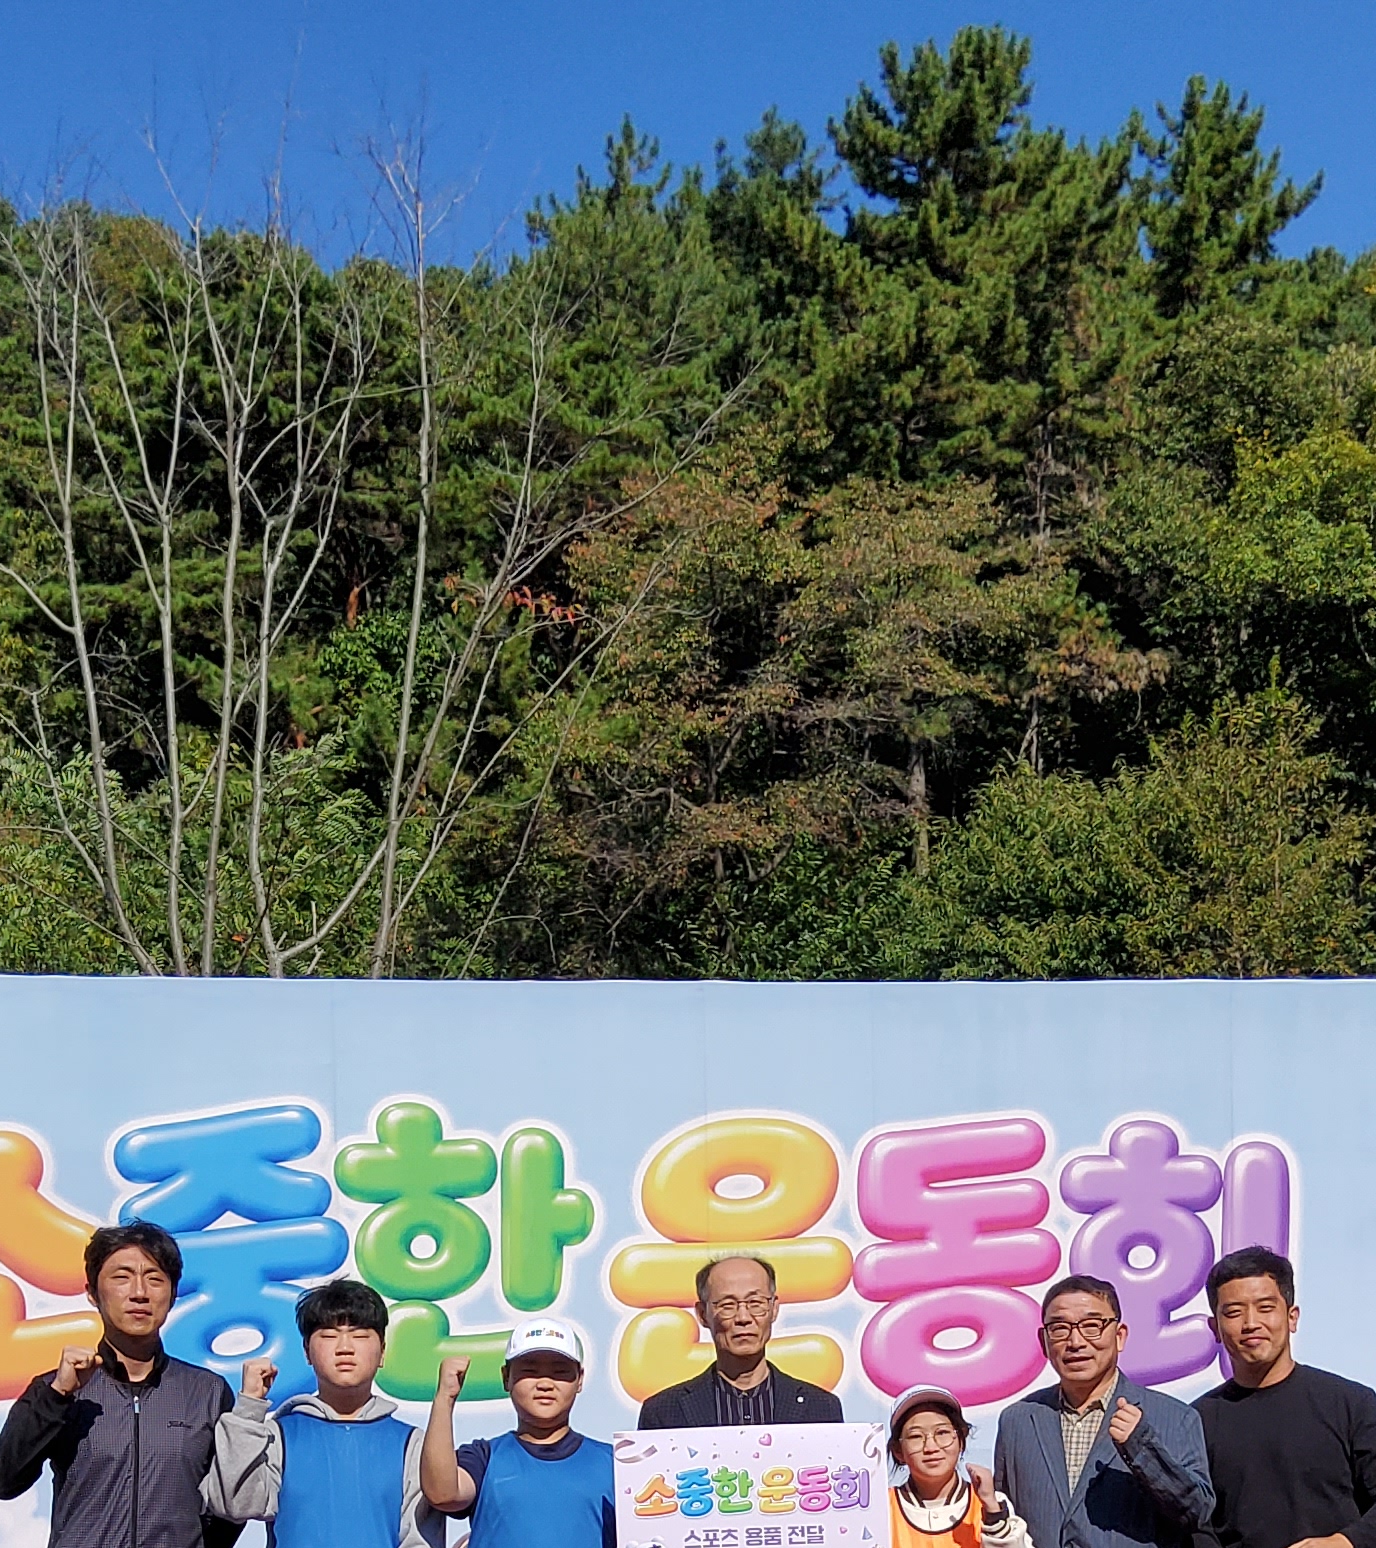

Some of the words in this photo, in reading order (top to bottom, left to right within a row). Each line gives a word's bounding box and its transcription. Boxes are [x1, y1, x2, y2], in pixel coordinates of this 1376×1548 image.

[609, 1116, 1290, 1406] 운동회
[633, 1465, 754, 1518] 소중한
[757, 1464, 872, 1514] 운동회
[744, 1526, 782, 1547] 용품
[787, 1524, 825, 1545] 전달
